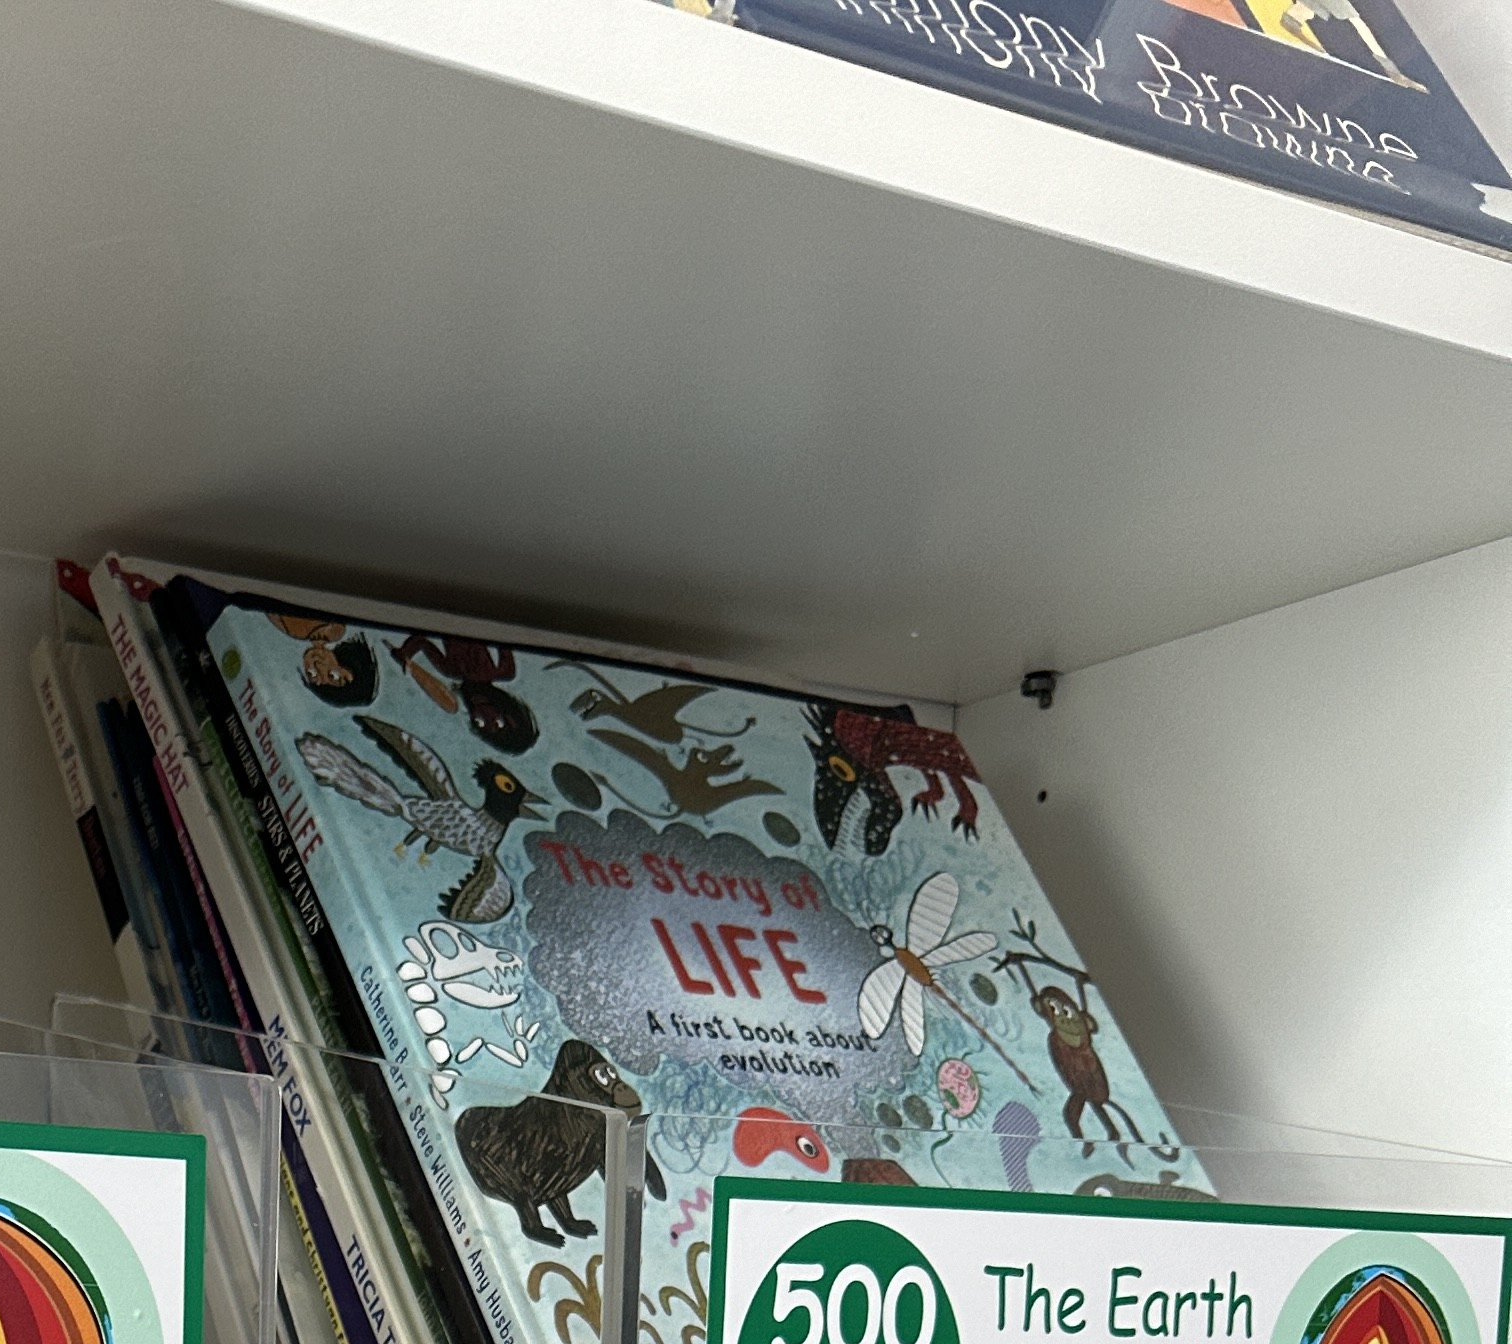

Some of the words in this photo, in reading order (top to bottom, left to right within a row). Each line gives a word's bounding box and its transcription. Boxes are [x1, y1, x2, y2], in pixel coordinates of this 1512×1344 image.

[1137, 34, 1418, 164] Browne
[111, 613, 137, 667] THE
[130, 666, 169, 746] MAGIC
[161, 745, 189, 795] HAT
[238, 678, 257, 722] The
[255, 718, 281, 777] Story
[277, 775, 295, 796] of
[258, 795, 287, 847] STARS
[283, 793, 324, 864] LIFE
[279, 847, 294, 864] &
[539, 840, 632, 889] The
[642, 853, 773, 916] Story
[782, 874, 822, 912] of
[284, 860, 324, 935] PLANETS
[651, 918, 827, 1004] LIFE
[360, 965, 400, 1050] Catherine
[647, 1011, 663, 1035] A
[671, 1012, 727, 1041] first
[738, 1016, 799, 1046] book
[808, 1022, 879, 1053] about
[387, 1048, 409, 1093] Barr
[721, 1052, 841, 1080] evolution
[408, 1104, 434, 1158] Steve
[282, 1076, 312, 1138] FOX
[344, 1234, 387, 1332] TRICIA
[430, 1155, 467, 1236] Williams
[467, 1248, 490, 1294] Amy
[983, 1262, 1086, 1337] The
[1108, 1266, 1254, 1341] Earth
